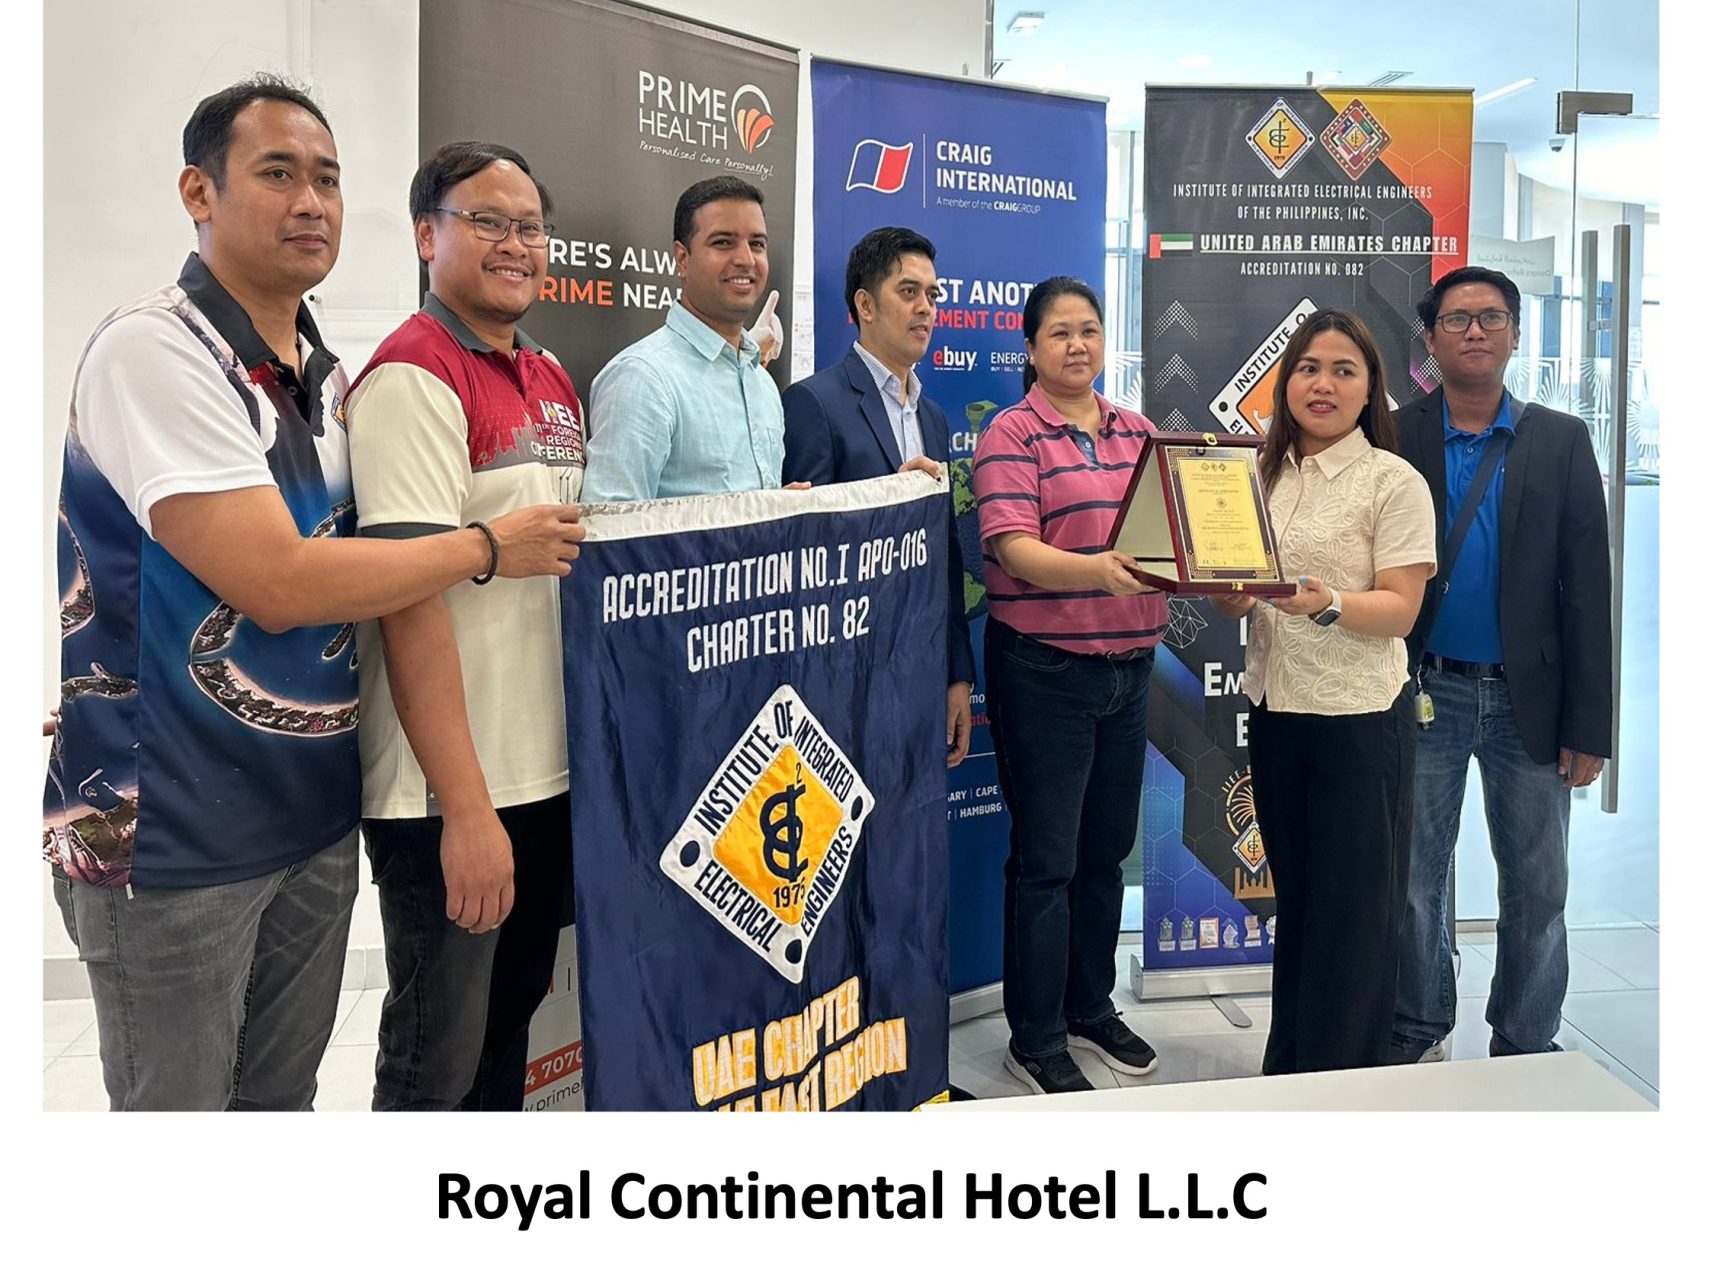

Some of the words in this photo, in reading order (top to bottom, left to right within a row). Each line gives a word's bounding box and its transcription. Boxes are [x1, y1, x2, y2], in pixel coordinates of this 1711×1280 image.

[638, 70, 727, 122] PRIME
[638, 107, 728, 150] HEALTH
[639, 140, 696, 161] Personalised
[700, 153, 721, 165] Care
[936, 140, 992, 166] CRAIG
[936, 168, 1077, 201] INTERNATIONAL
[1173, 183, 1228, 197] INSTITUTE
[1231, 183, 1244, 197] OF
[1247, 184, 1310, 198] INTEGRATED
[1314, 185, 1372, 199] ELECTRICAL
[1376, 186, 1433, 199] ENGINEERS
[936, 196, 942, 206] A
[942, 199, 971, 209] member
[1237, 206, 1250, 220] OF
[1253, 206, 1272, 220] THE
[1275, 206, 1344, 221] PHILIPPINES,
[1347, 207, 1369, 220] INC.
[545, 235, 612, 269] RE'S
[620, 246, 681, 277] ALW
[1200, 234, 1254, 251] UNITED
[1261, 235, 1303, 251] ARAB
[1310, 235, 1384, 252] EMIRATES
[1391, 236, 1458, 252] CHAPTER
[1240, 262, 1321, 276] ACCREDITATION
[1325, 262, 1341, 276] NO.
[1345, 263, 1364, 276] 082
[969, 281, 1036, 308] ANOT
[933, 345, 978, 372] ebuy
[1234, 326, 1291, 393] INSTITUTE
[603, 550, 793, 624] ACCREDITATION
[858, 527, 928, 582] APO-016
[686, 610, 795, 673] CHARTER
[801, 605, 836, 648] NO.
[842, 596, 871, 640] 82
[694, 724, 779, 837] INSTITUTE
[774, 700, 793, 740] OF
[794, 715, 854, 803] INTEGRATED
[948, 789, 968, 802] ARY
[975, 785, 999, 798] CAPE
[960, 803, 1002, 818] HAMBURG
[693, 859, 783, 954] ELECTRICAL
[800, 825, 854, 937] ENGINEERS
[692, 1027, 757, 1107] UAE
[763, 975, 860, 1082] CHAPTER
[824, 1016, 908, 1111] REGION
